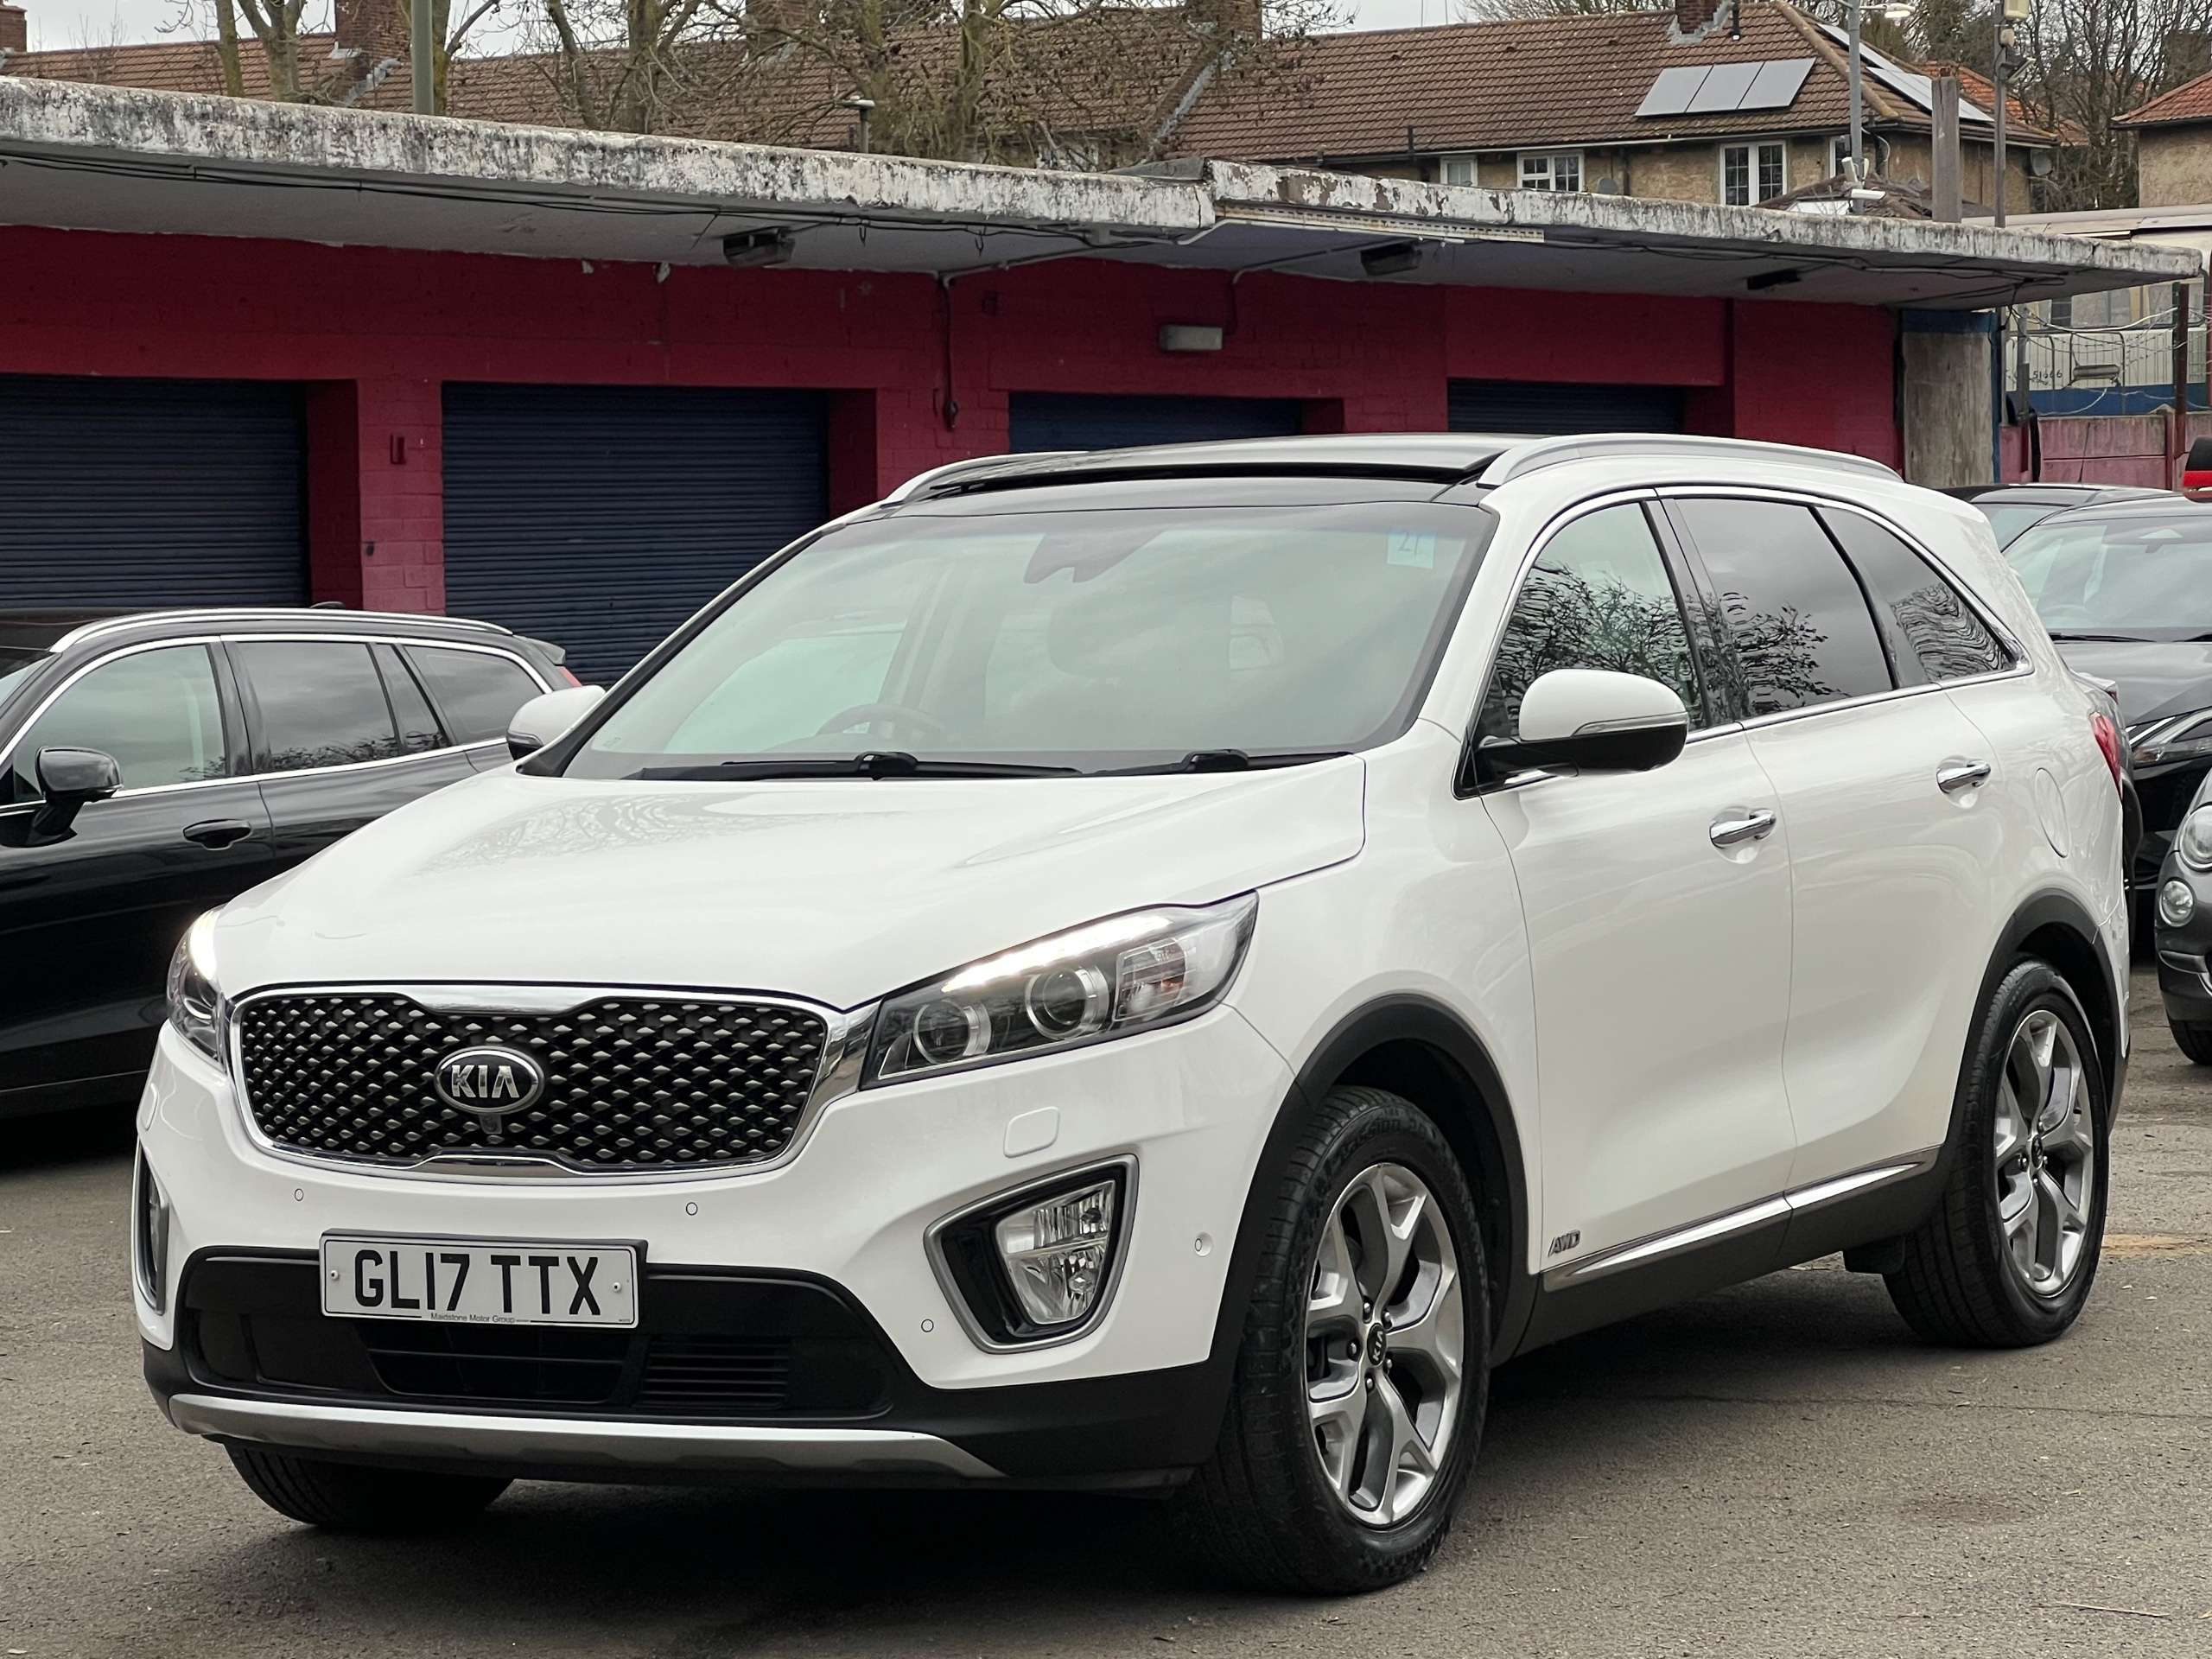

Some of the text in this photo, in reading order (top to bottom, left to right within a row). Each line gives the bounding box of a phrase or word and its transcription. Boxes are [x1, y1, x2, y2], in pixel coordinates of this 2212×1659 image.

[452, 1065, 519, 1098] KIA
[1548, 1230, 1580, 1257] AWD
[354, 1249, 601, 1315] GL17 TTX
[430, 1313, 467, 1322] Maidstone
[469, 1313, 490, 1322] Motor
[1372, 1331, 1383, 1362] KIA
